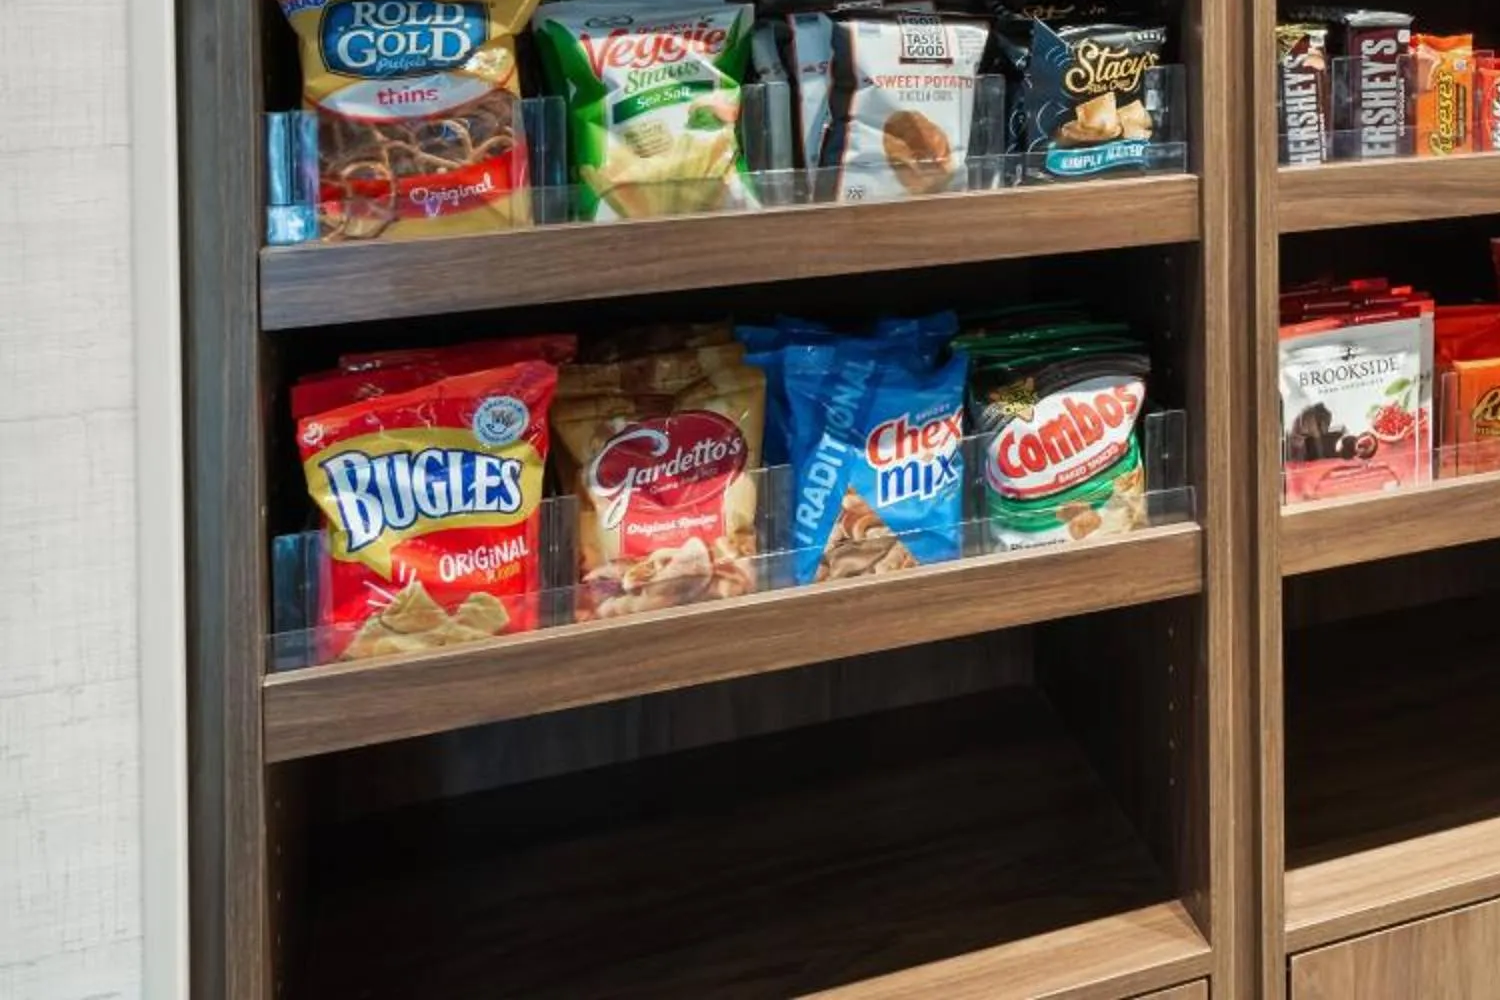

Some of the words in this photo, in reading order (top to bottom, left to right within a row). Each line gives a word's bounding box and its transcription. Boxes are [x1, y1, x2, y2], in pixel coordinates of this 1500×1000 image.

[350, 1, 465, 29] ROLD
[337, 27, 471, 69] GOLD
[580, 20, 727, 78] Veggie
[906, 33, 943, 45] TASTE
[907, 45, 945, 56] GOOD
[623, 59, 700, 94] Straws
[873, 75, 920, 89] SWEET
[923, 75, 973, 89] POTATO
[1065, 37, 1160, 93] Stacy's
[376, 86, 440, 106] thins
[636, 92, 661, 107] Sea
[663, 85, 691, 101] Salt
[1283, 53, 1322, 166] HERSHEY'S
[1360, 39, 1398, 158] ERSHEY'S
[408, 172, 495, 206] Original
[1298, 357, 1400, 387] BROOKSIDE
[867, 410, 963, 469] Chex
[997, 384, 1137, 479] Combos
[796, 358, 876, 545] TRADITIONAL
[590, 428, 742, 530] Gardetto's
[321, 450, 523, 552] BUGLES
[627, 519, 674, 535] Original
